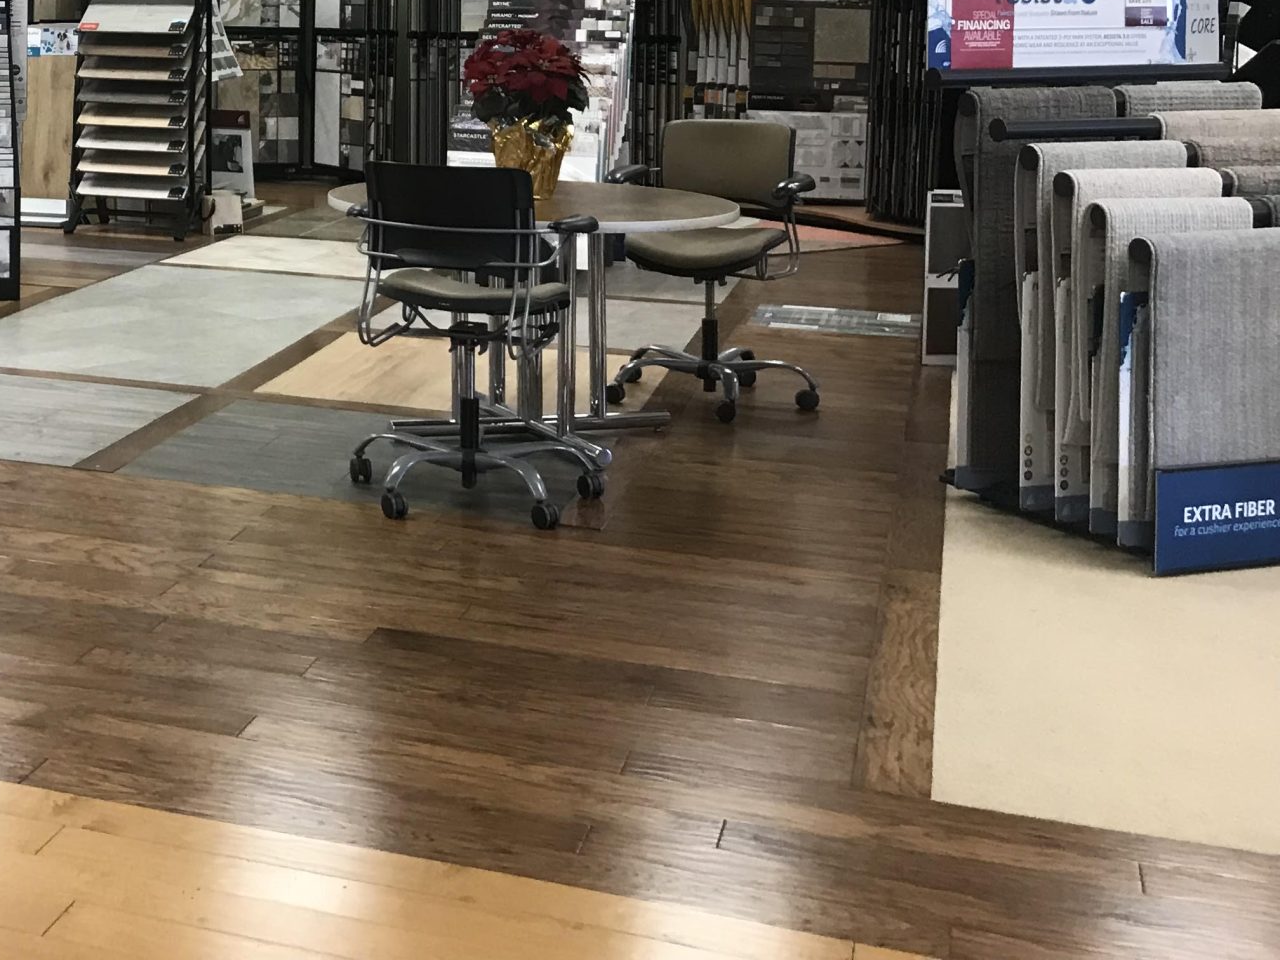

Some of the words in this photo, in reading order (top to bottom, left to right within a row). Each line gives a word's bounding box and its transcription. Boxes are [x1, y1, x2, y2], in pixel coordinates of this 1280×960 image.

[972, 10, 998, 20] SPECIAL
[957, 20, 1011, 31] FINANCING
[1190, 17, 1216, 34] CORE
[963, 30, 1001, 41] AVAILABLE
[1183, 504, 1232, 523] EXTRA
[1235, 499, 1275, 518] FIBER
[1174, 525, 1187, 537] for
[1190, 527, 1196, 536] a
[1197, 522, 1232, 535] cushier
